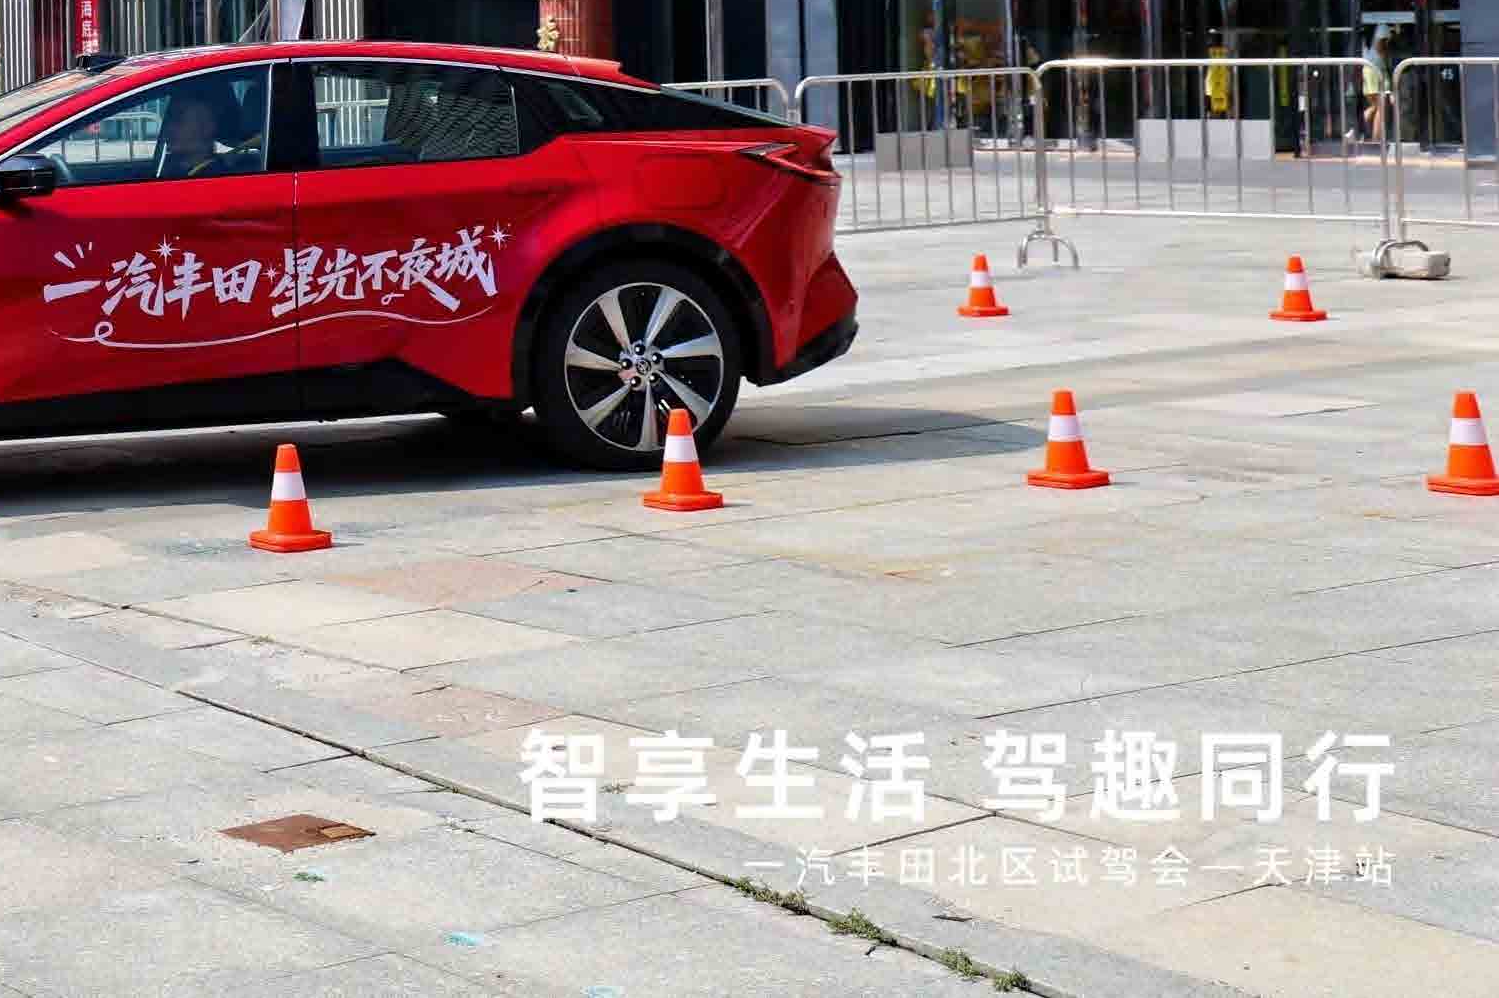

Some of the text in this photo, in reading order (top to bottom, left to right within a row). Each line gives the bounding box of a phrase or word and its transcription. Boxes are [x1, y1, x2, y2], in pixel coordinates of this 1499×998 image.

[44, 225, 498, 322] 一汽丰田 星光不夜城
